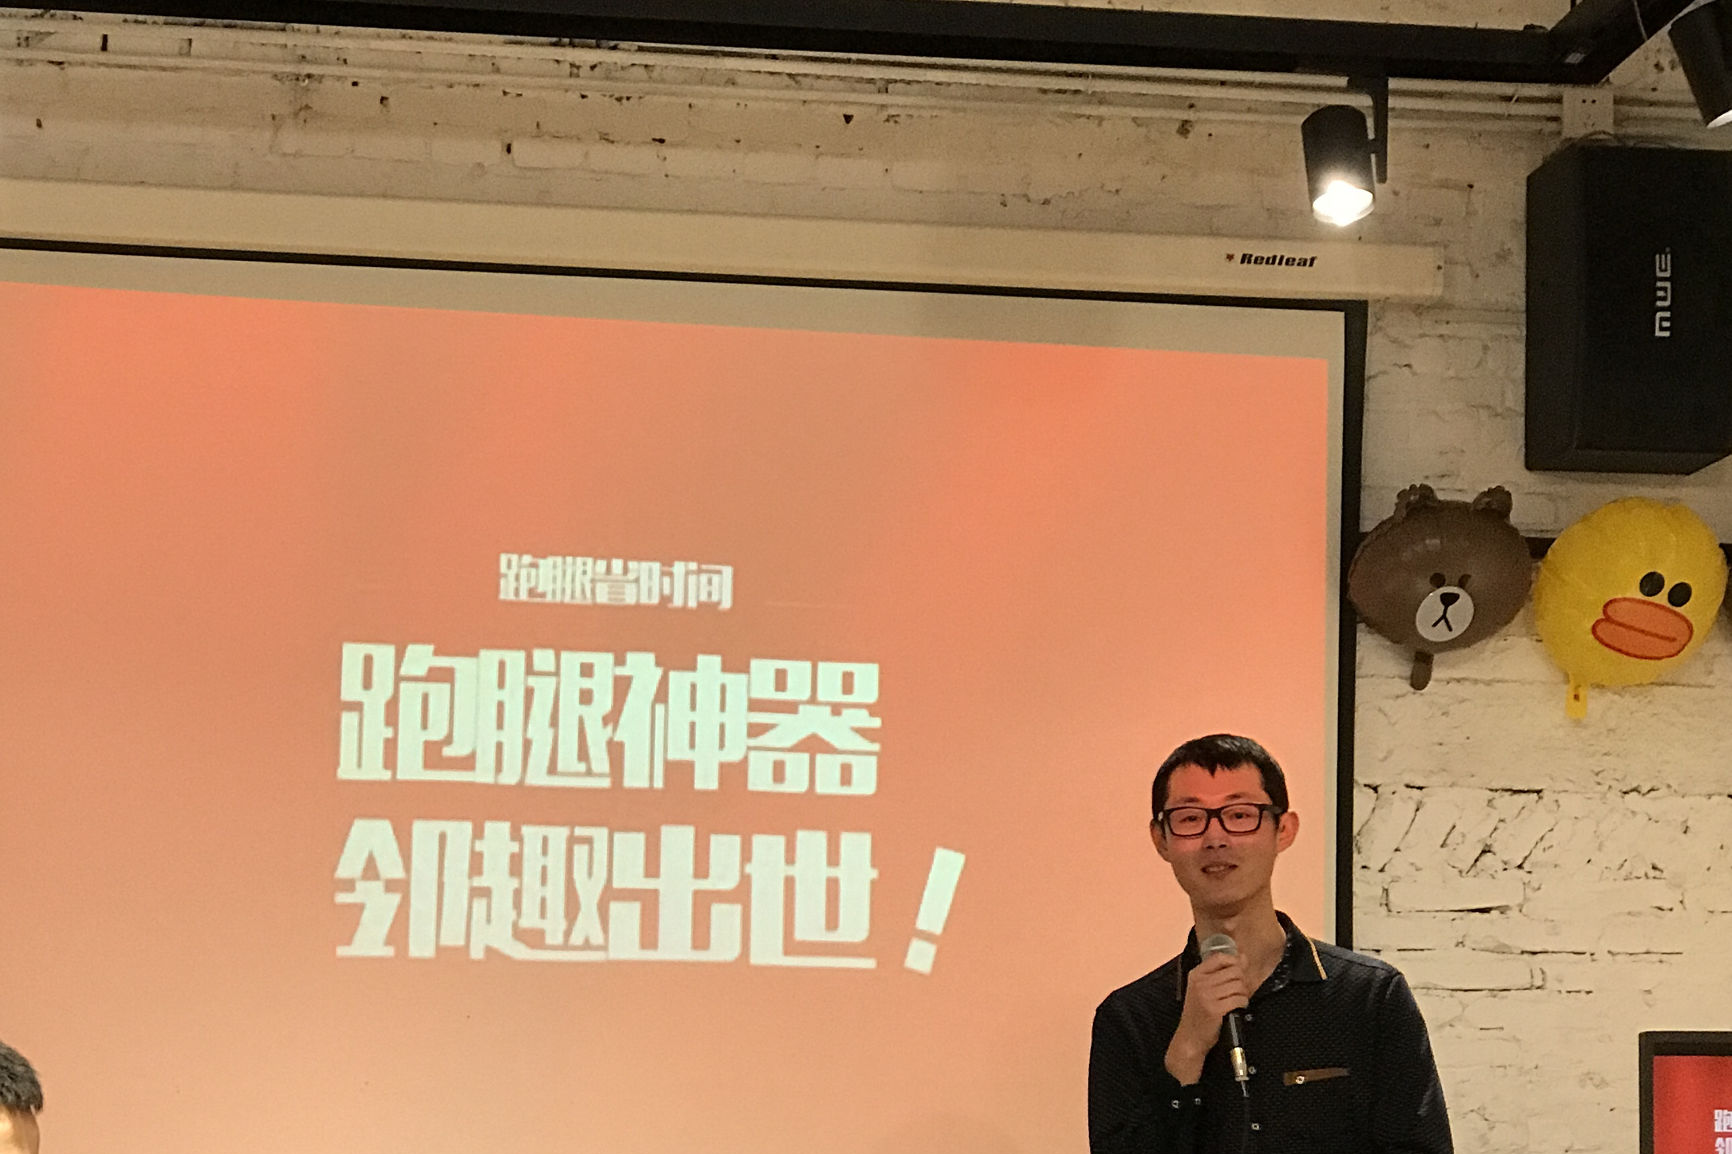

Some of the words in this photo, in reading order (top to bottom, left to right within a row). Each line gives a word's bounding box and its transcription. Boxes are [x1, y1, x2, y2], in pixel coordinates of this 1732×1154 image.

[1240, 253, 1317, 267] Redleaf
[1655, 253, 1671, 336] MWE
[499, 553, 733, 610] 跑腿省时间
[337, 642, 881, 796] 跑腿神器
[334, 818, 966, 975] 邻趣出世！
